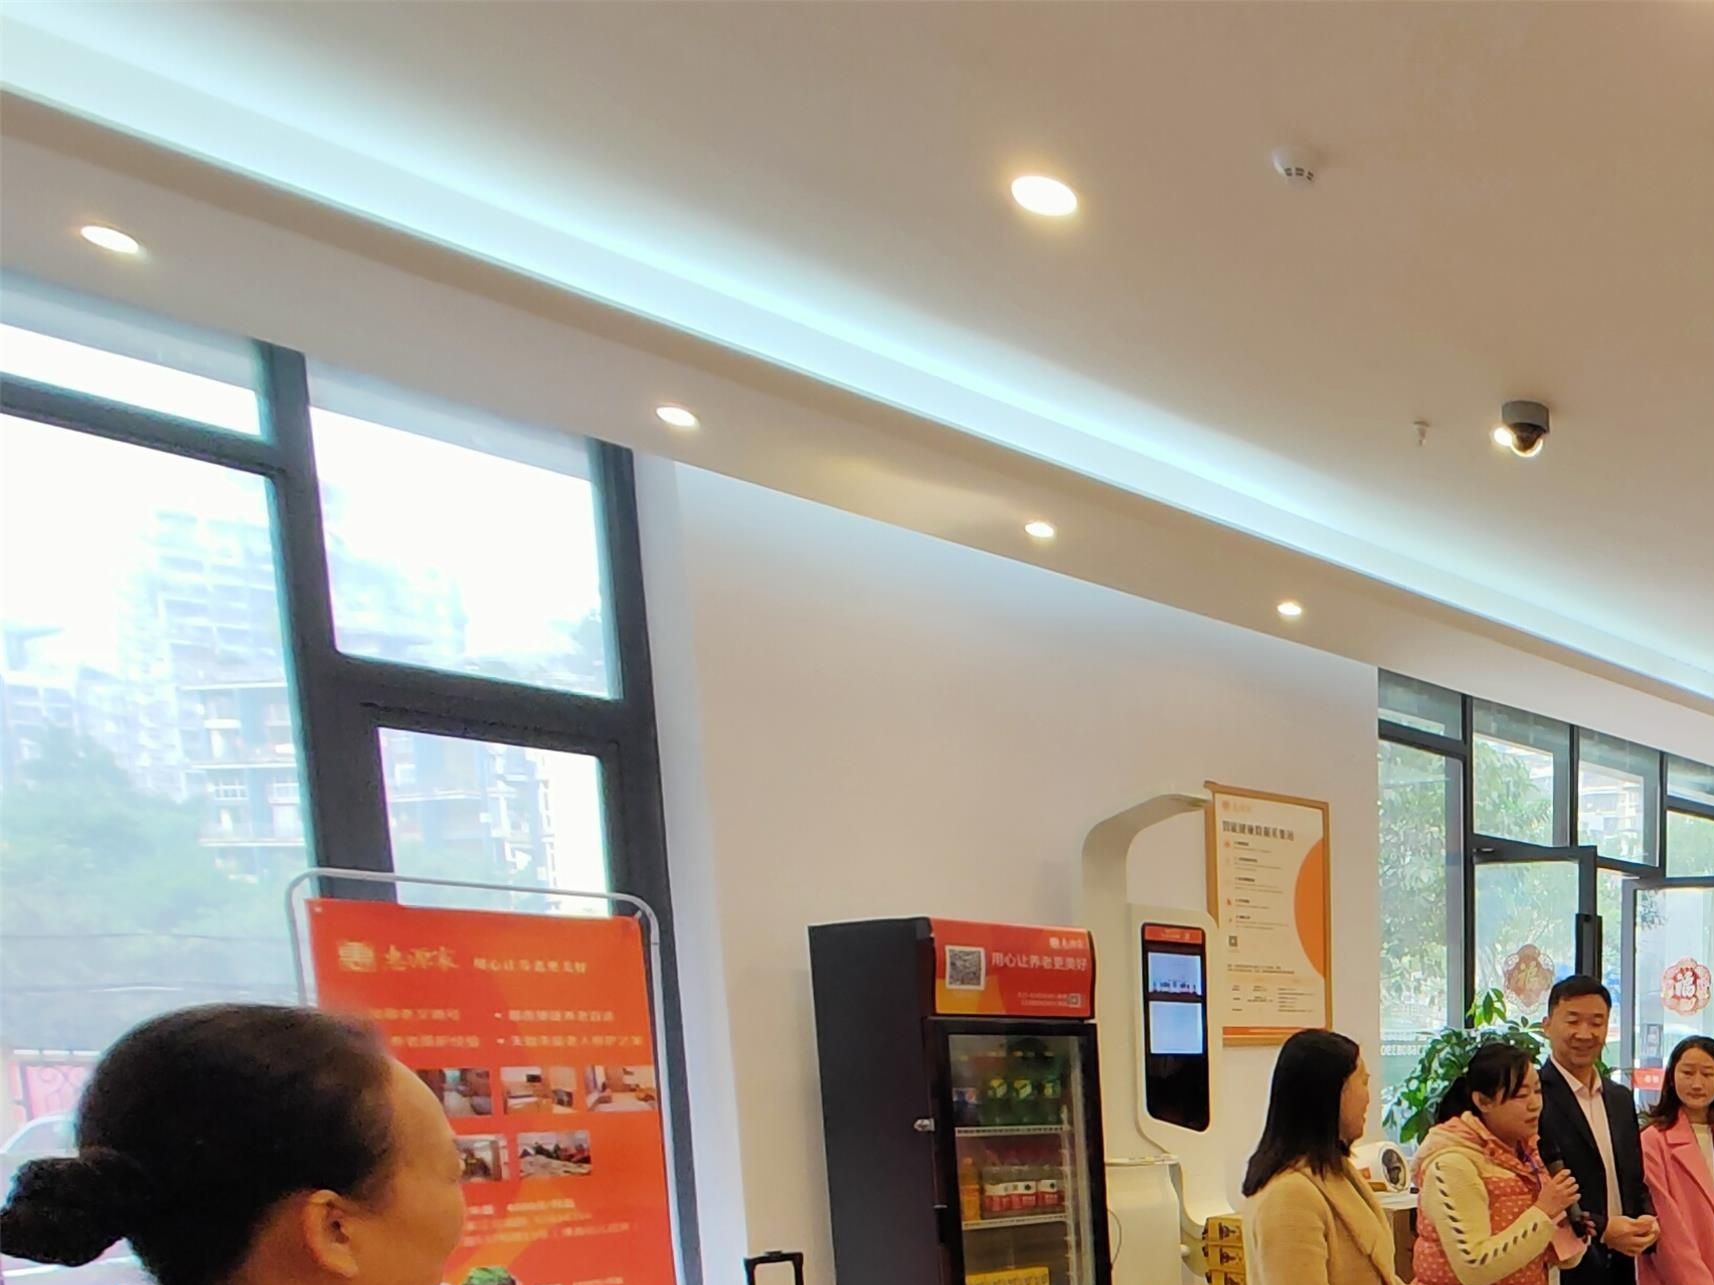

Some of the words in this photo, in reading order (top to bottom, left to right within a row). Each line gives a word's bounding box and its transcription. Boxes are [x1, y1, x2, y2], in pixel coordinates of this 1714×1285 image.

[992, 952, 1088, 972] 用心让养老更美好
